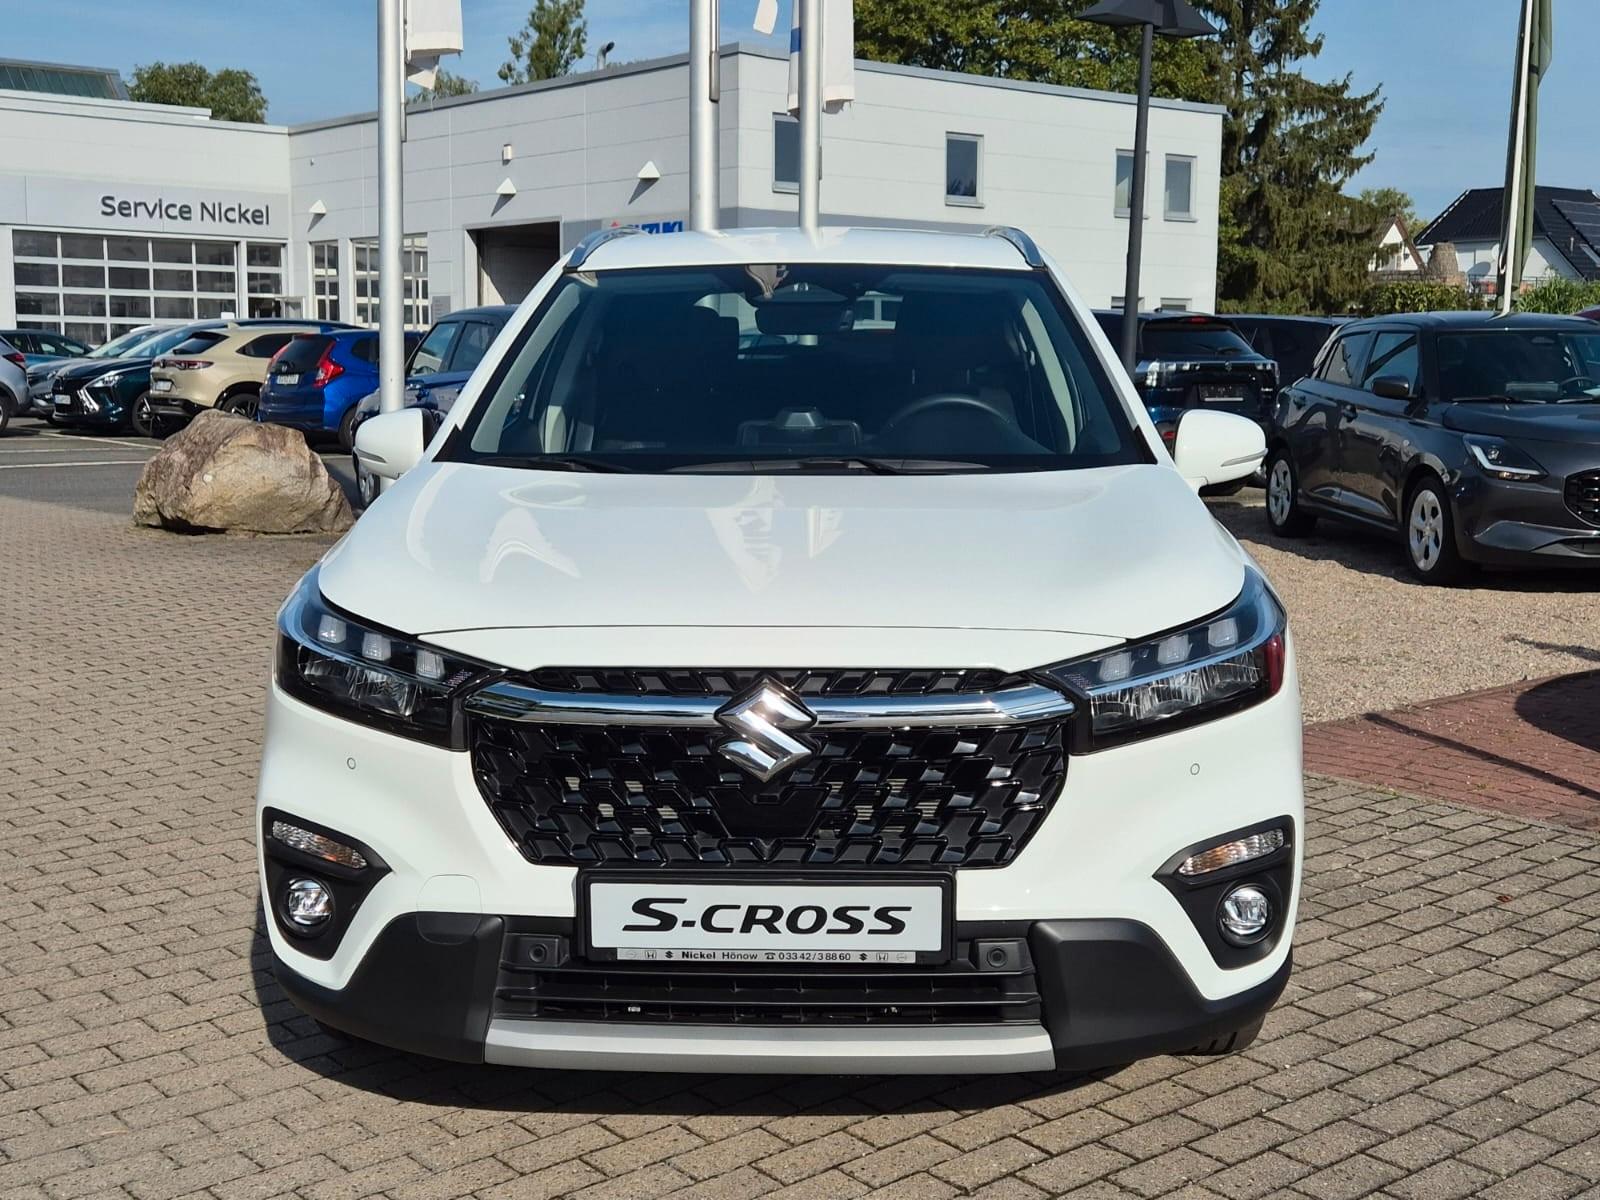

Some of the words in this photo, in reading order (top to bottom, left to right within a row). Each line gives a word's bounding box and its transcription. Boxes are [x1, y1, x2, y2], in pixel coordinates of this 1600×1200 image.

[100, 195, 193, 221] Service
[200, 201, 270, 226] Nickel
[622, 897, 913, 935] S-CROSS
[681, 950, 717, 961] Nickel
[721, 951, 758, 961] Hönow
